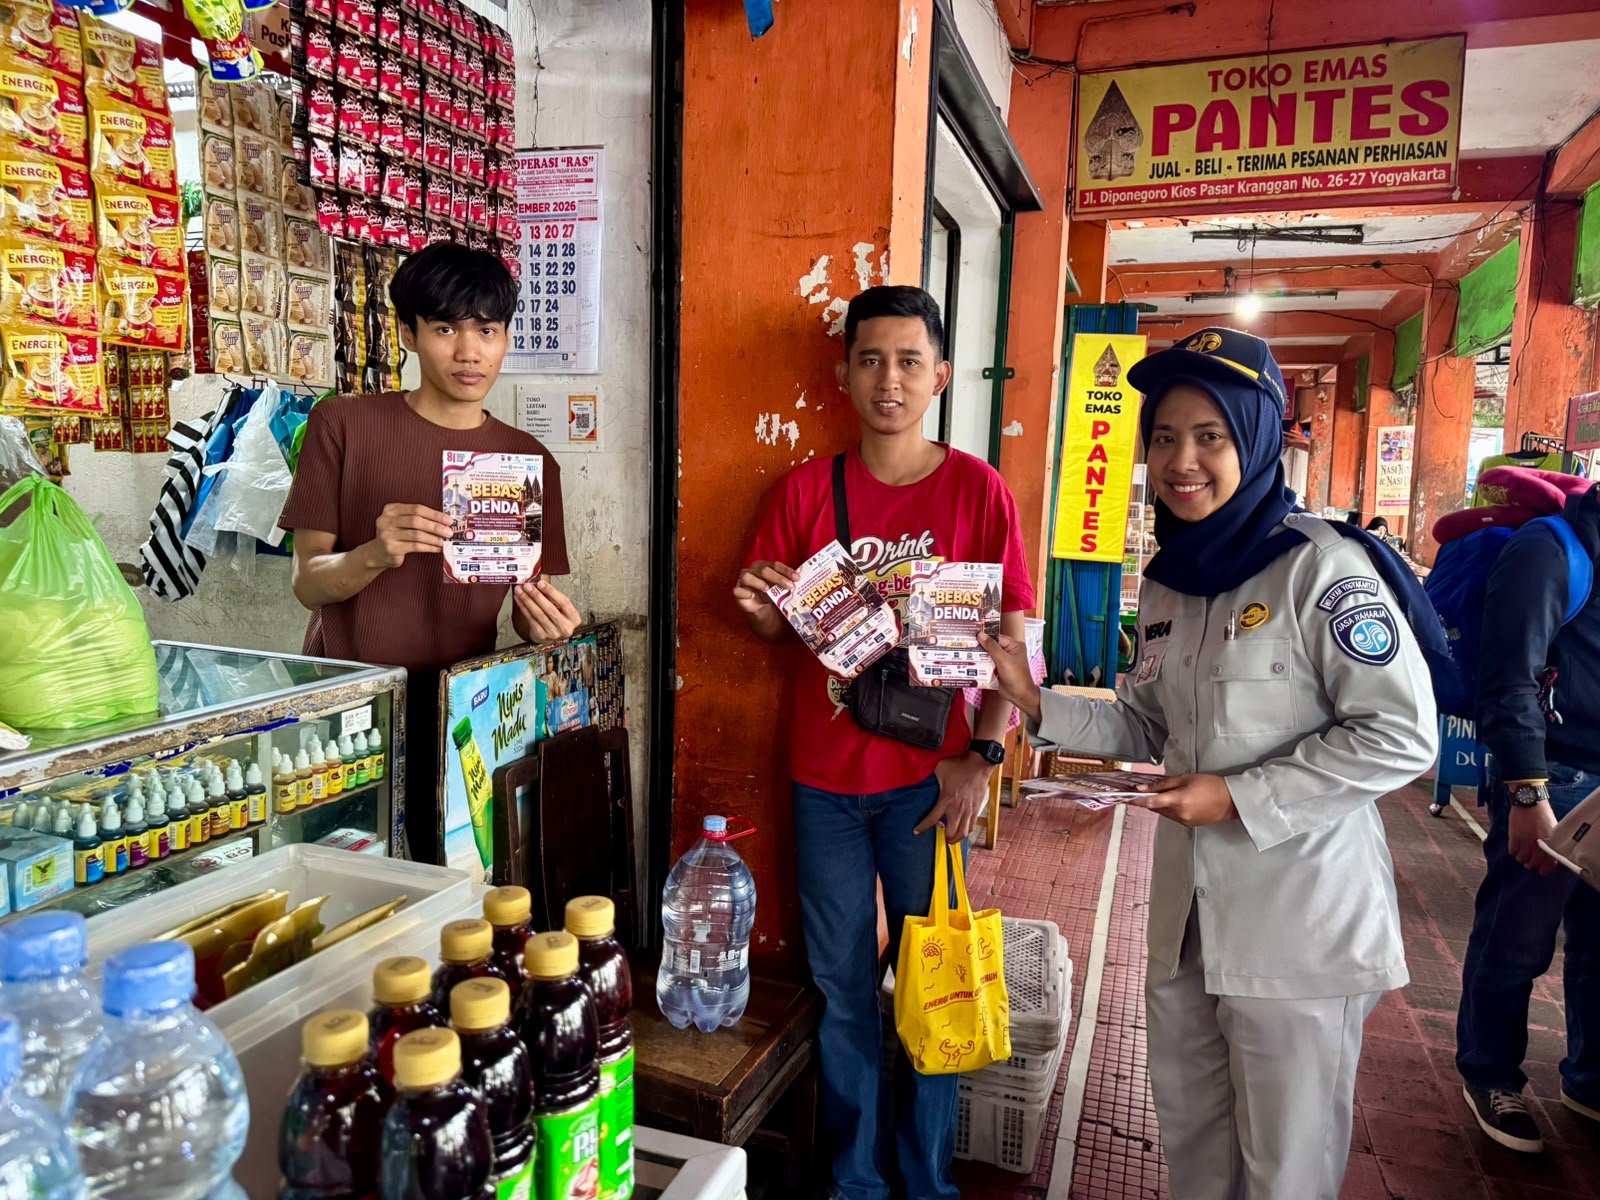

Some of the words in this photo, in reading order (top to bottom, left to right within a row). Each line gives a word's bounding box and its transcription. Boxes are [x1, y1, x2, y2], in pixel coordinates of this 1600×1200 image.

[88, 29, 132, 48] ENERGEN
[1208, 63, 1292, 92] TOKO
[1304, 53, 1388, 84] EMAS
[2, 76, 54, 93] ENERGEN
[100, 113, 143, 130] ENERGEN
[1151, 79, 1450, 157] PANTES
[1149, 161, 1181, 180] JUAL
[1195, 157, 1222, 176] BELI
[1237, 152, 1287, 173] TERIMA
[1291, 147, 1358, 169] PESANAN
[1363, 140, 1448, 163] PERHIASAN
[5, 165, 57, 180] ENERGEN
[1083, 192, 1097, 206] Jl.
[1100, 187, 1168, 206] Diponegoro
[1171, 184, 1196, 199] Kios
[1200, 180, 1234, 196] Pasar
[1238, 178, 1298, 195] Kranggan
[1302, 175, 1323, 189] No.
[1328, 172, 1366, 187] 26-27
[1370, 167, 1446, 185] Yogyakarta
[105, 198, 149, 210] ENERGEN
[552, 201, 576, 212] 2026
[530, 225, 541, 240] 13
[545, 224, 559, 239] 20
[562, 224, 575, 238] 27
[529, 244, 541, 258] 14
[547, 243, 558, 257] 21
[562, 242, 575, 257] 28
[9, 253, 60, 265] ENERGEN
[530, 263, 541, 276] 15
[545, 262, 559, 276] 22
[562, 261, 575, 276] 29
[111, 281, 155, 290] ENERGEN
[530, 280, 541, 295] 16
[545, 280, 559, 294] 23
[561, 280, 576, 294] 30
[530, 299, 541, 313] 17
[545, 299, 559, 313] 24
[515, 317, 523, 331] 11
[530, 317, 542, 331] 18
[546, 317, 559, 331] 25
[12, 340, 63, 350] ENERGEN
[513, 336, 525, 349] 12
[530, 336, 542, 349] 19
[546, 335, 559, 349] 26
[1086, 390, 1123, 401] TOKO
[1085, 404, 1121, 414] EMAS
[1080, 420, 1111, 553] PANTES
[471, 500, 520, 515] DENDA
[851, 530, 935, 574] Drink
[812, 586, 853, 620] DENDA
[934, 606, 979, 621] DENDA
[1337, 617, 1355, 632] JASA
[1354, 610, 1387, 622] RAHARJA
[497, 683, 524, 723] Nipis
[491, 707, 527, 761] Madu
[949, 990, 974, 1000] UNTUK
